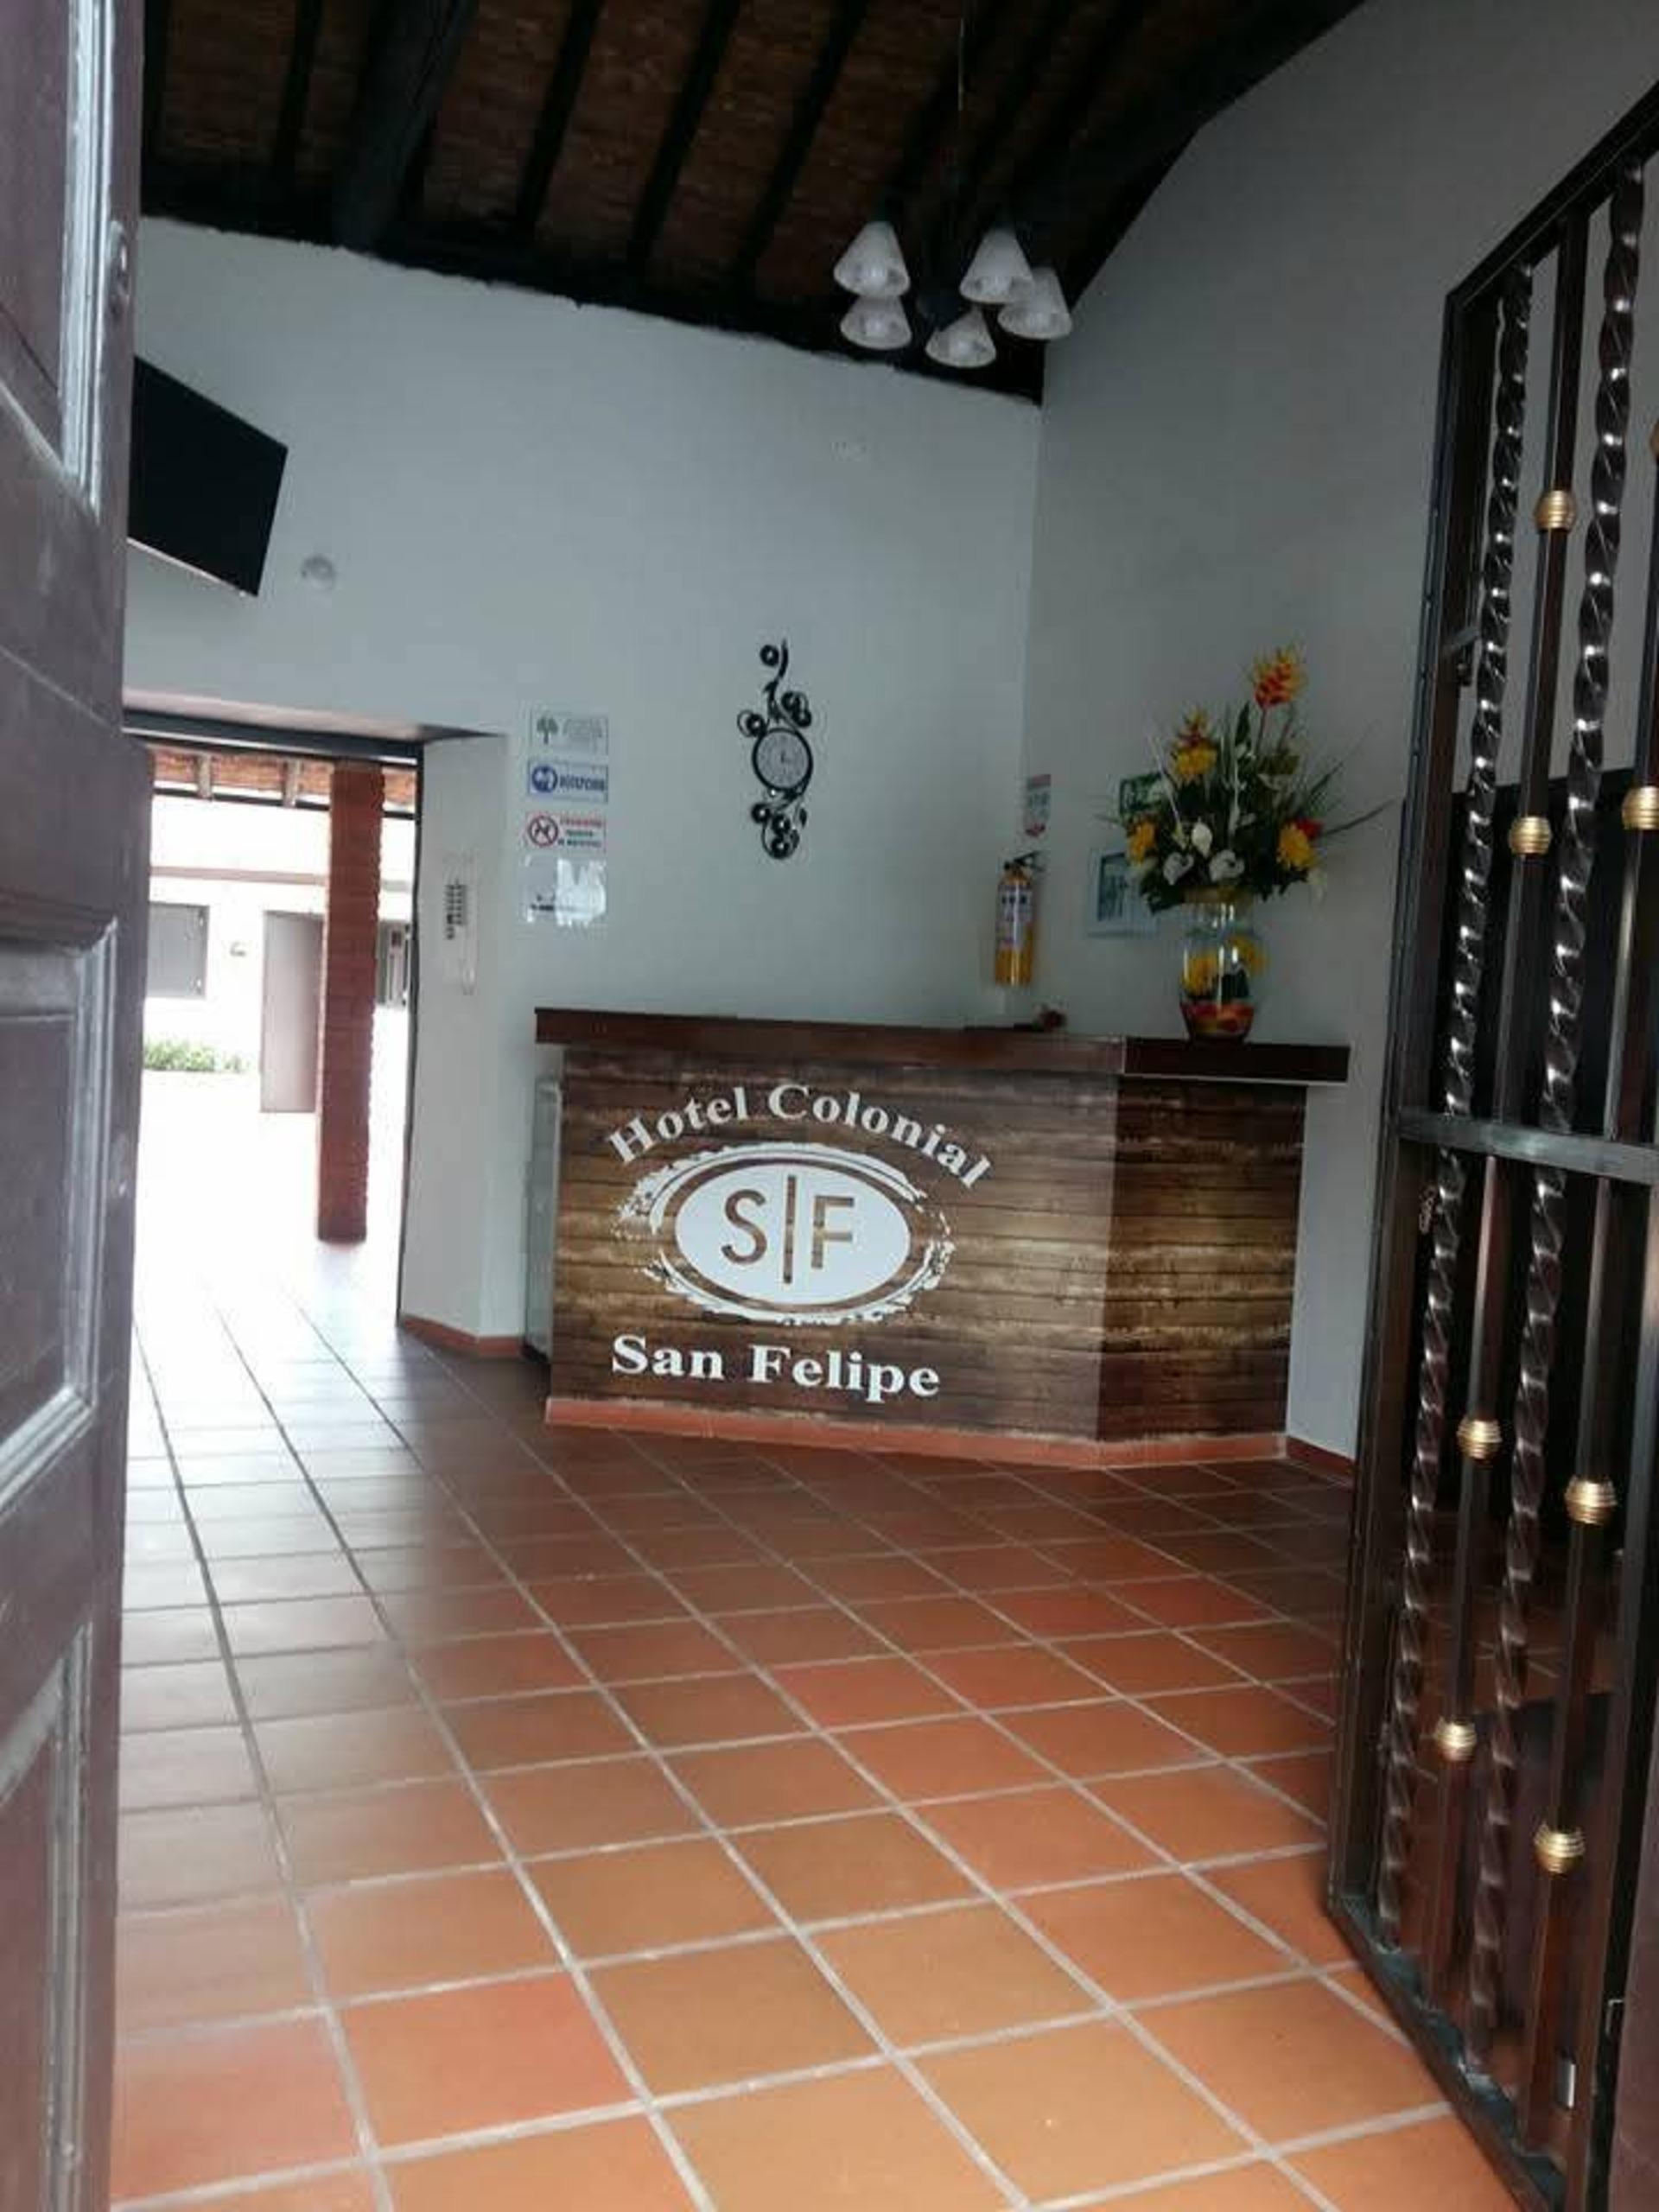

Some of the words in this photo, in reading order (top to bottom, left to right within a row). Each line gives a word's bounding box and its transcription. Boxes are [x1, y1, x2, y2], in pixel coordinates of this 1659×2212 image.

[607, 1086, 748, 1164] Hotel
[768, 1083, 992, 1189] Colonial
[612, 1333, 726, 1381] San
[748, 1344, 941, 1404] Felipe
